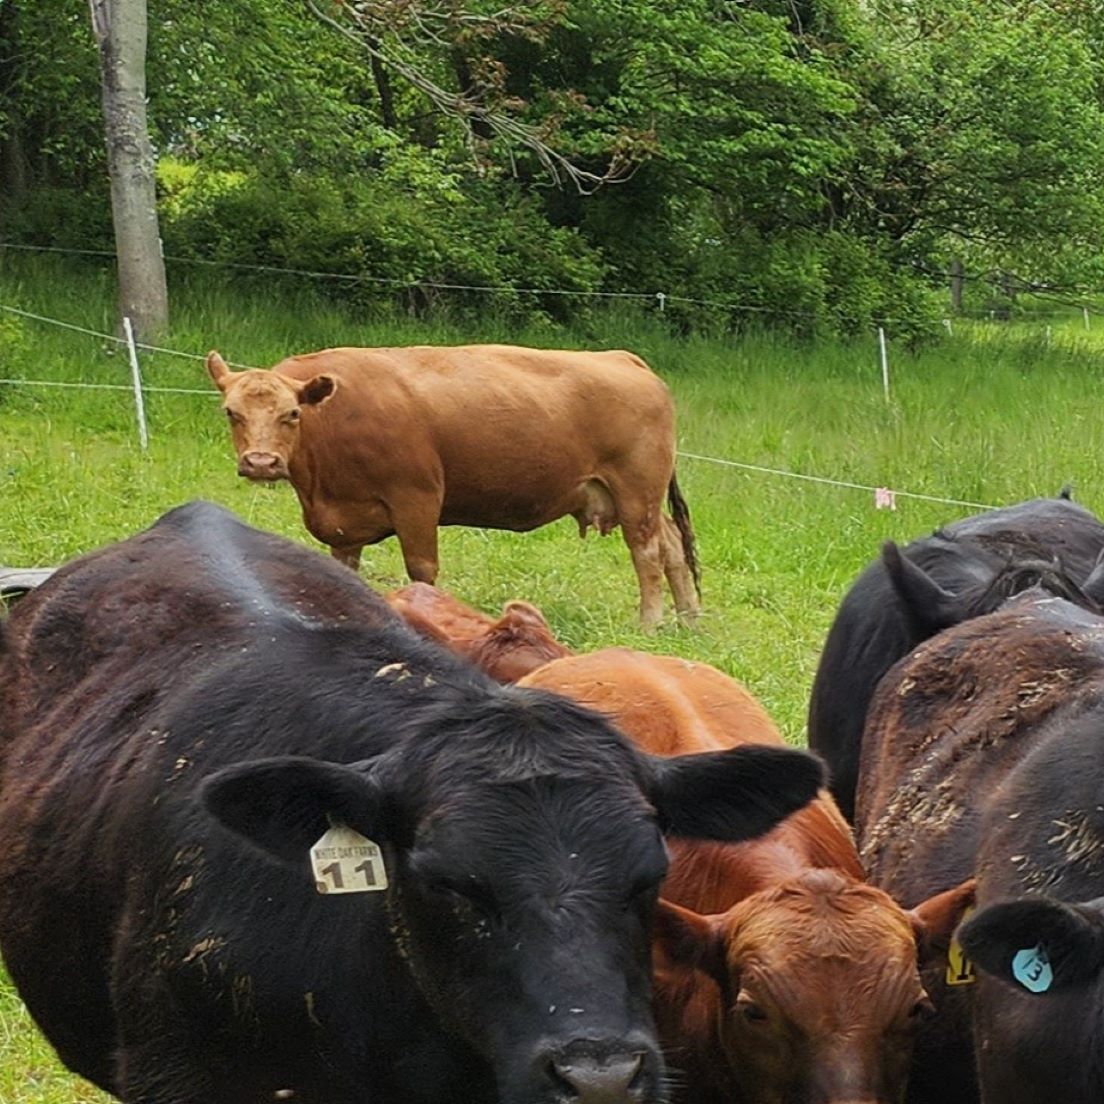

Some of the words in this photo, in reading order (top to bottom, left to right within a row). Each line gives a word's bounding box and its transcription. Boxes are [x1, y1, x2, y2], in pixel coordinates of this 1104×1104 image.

[314, 847, 337, 860] WHITE
[338, 847, 354, 859] OAK
[321, 860, 376, 889] 11
